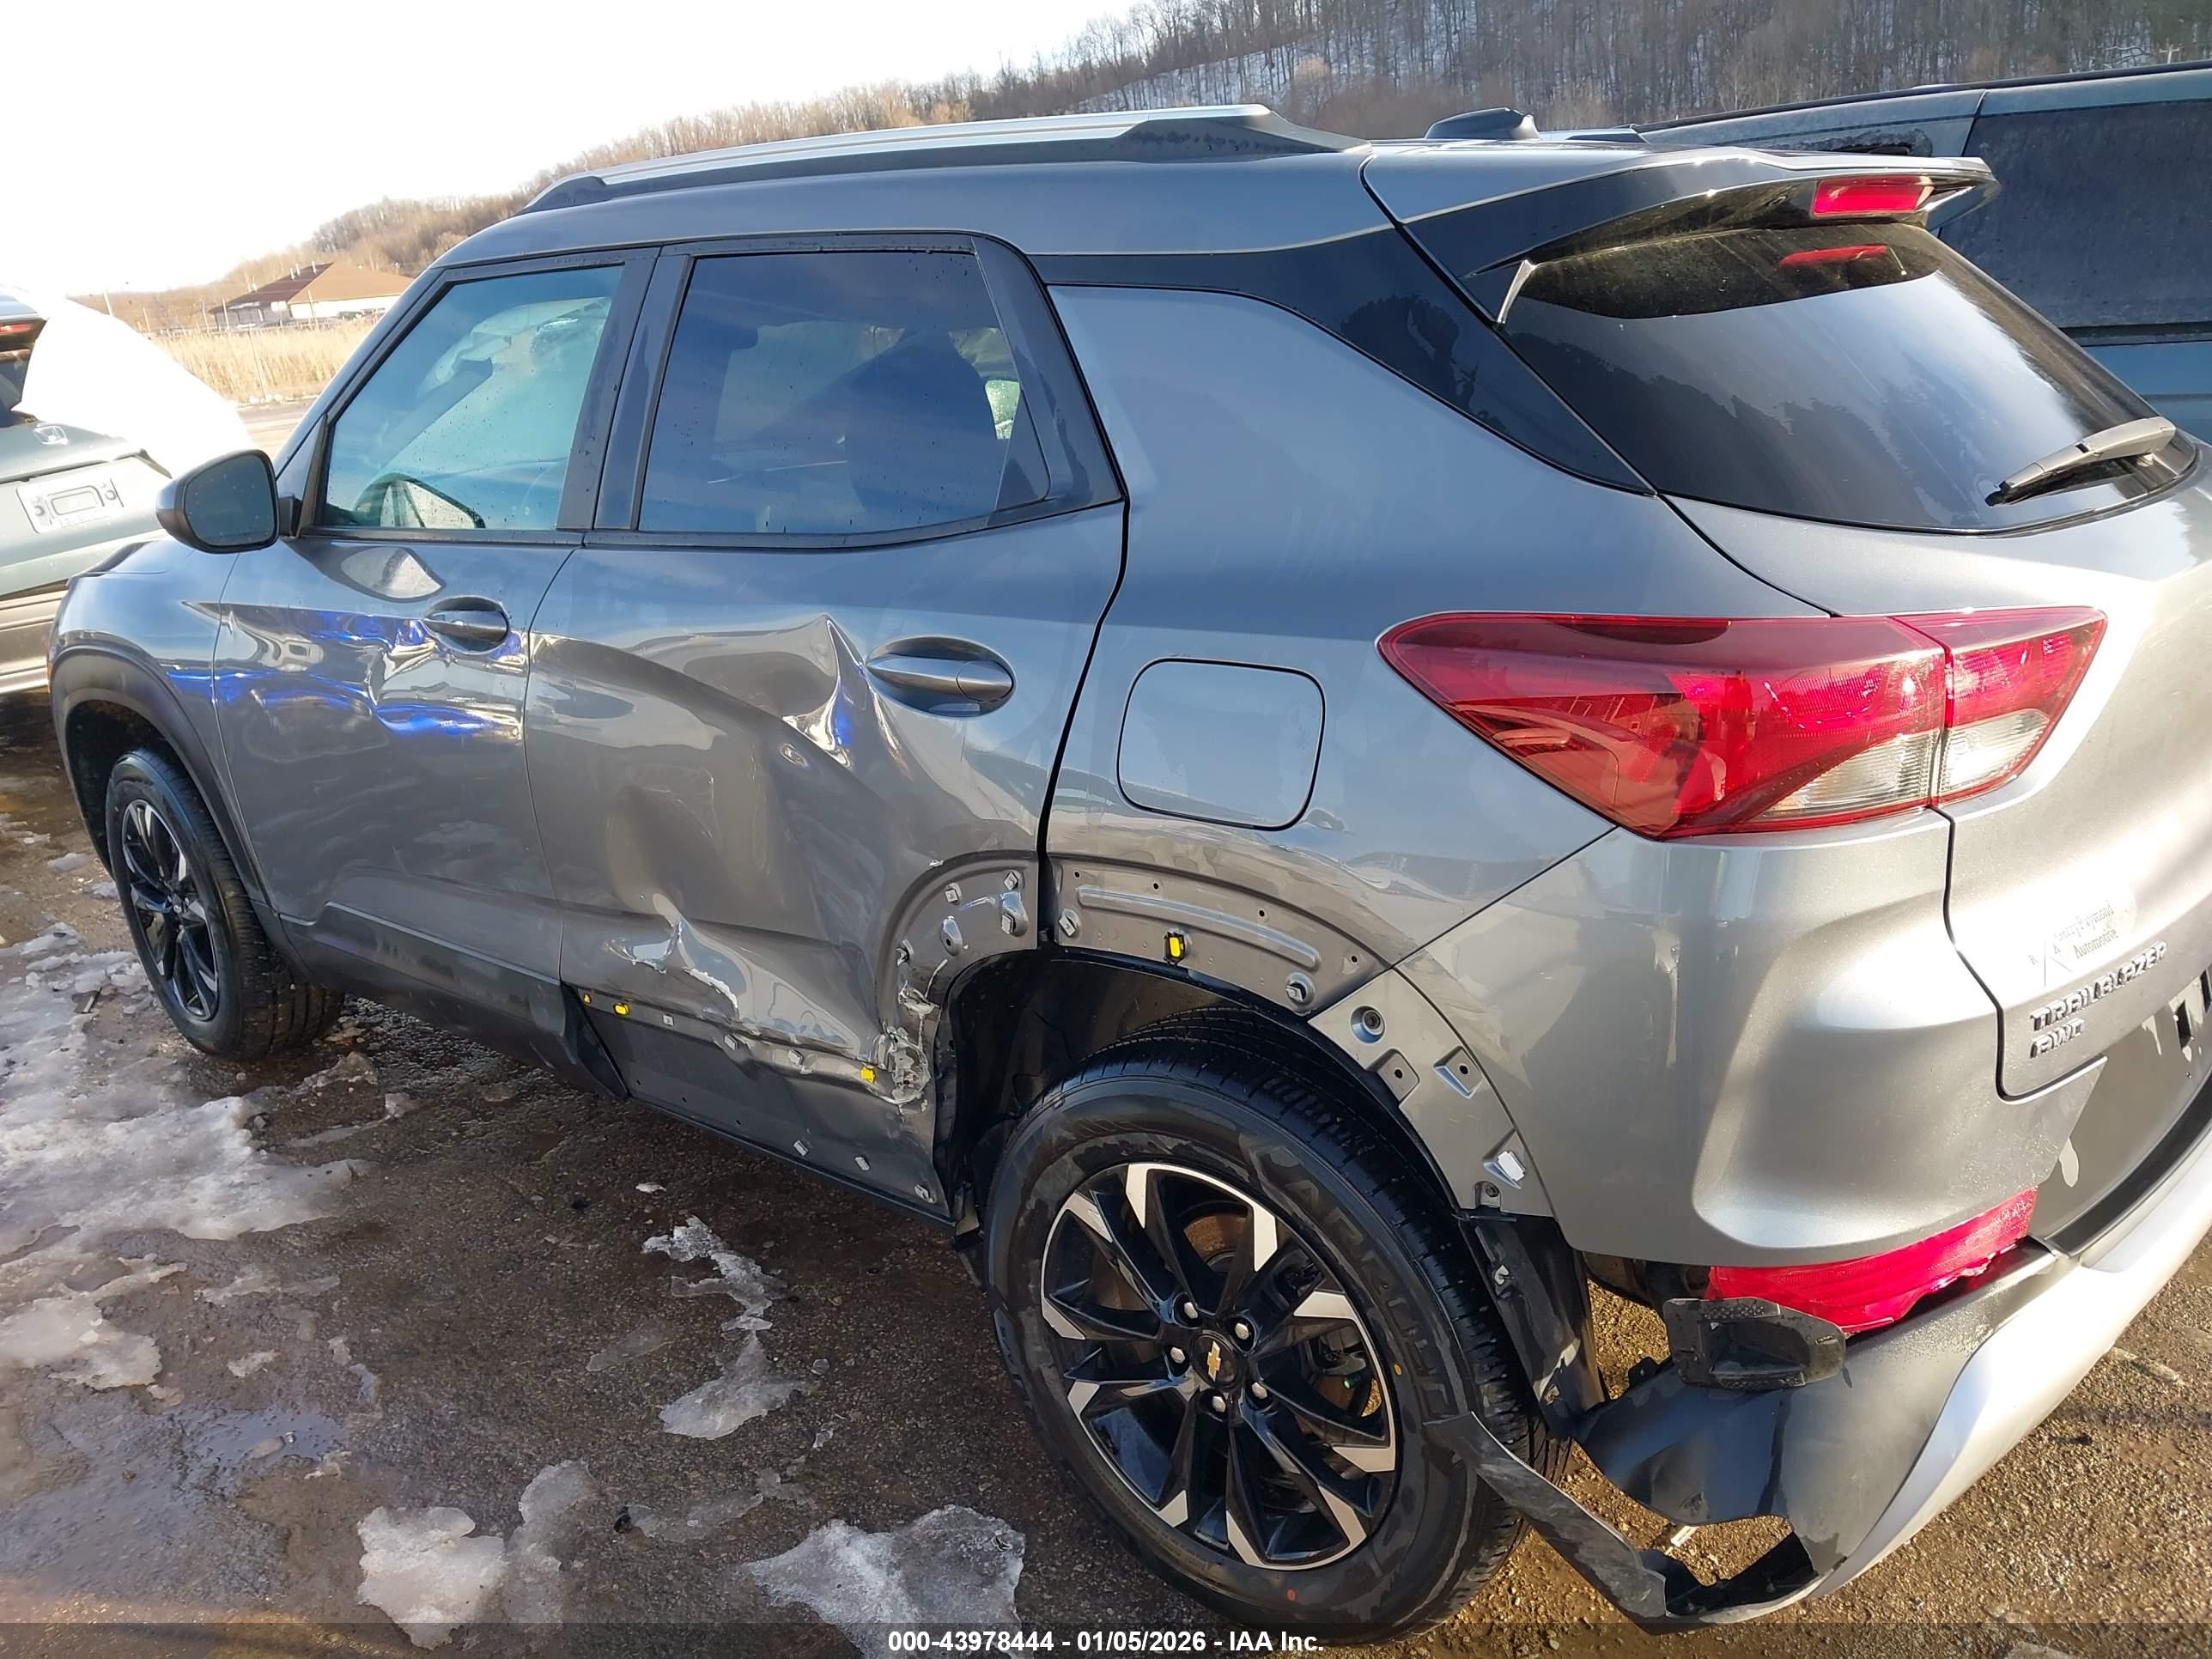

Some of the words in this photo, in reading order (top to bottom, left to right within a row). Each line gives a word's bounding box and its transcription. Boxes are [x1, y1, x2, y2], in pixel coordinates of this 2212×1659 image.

[2073, 927, 2119, 959] Automotive
[2029, 940, 2167, 1031] TRAILBLAZER
[2029, 1017, 2085, 1059] AWD
